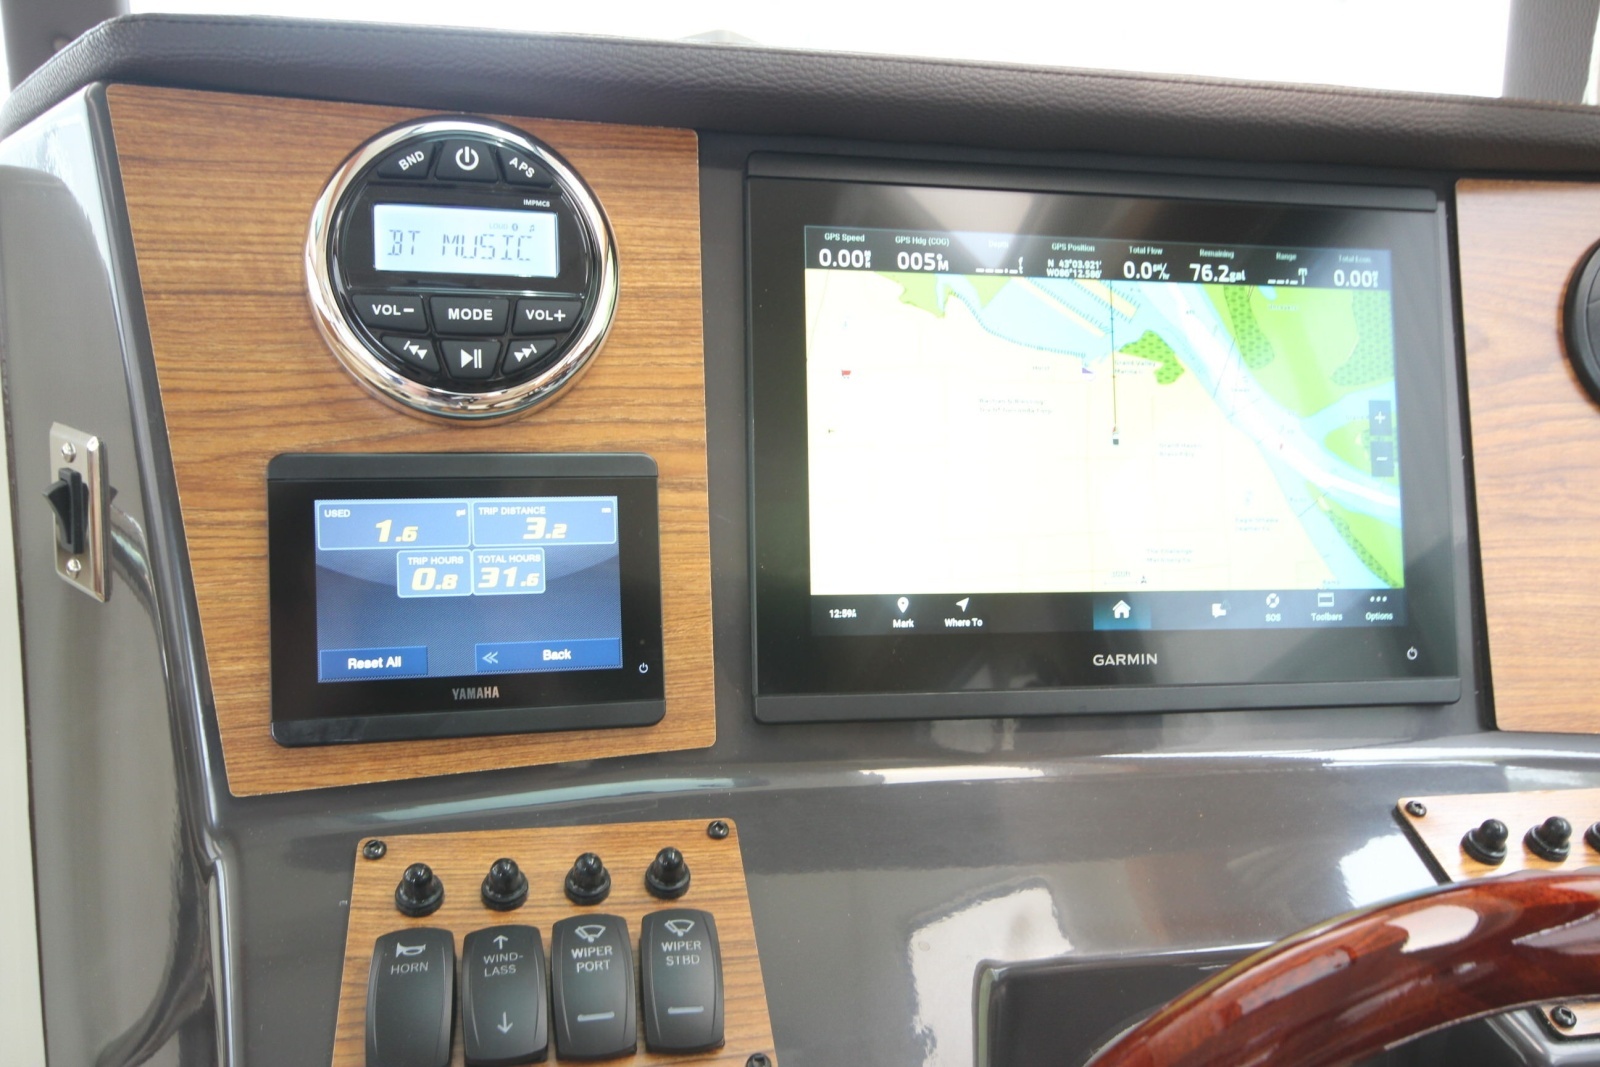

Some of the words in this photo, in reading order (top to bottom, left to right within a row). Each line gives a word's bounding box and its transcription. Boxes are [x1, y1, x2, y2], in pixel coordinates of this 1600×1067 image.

[398, 150, 425, 171] BND
[508, 156, 535, 178] APS
[824, 232, 840, 241] GPS
[841, 233, 866, 243] Speed
[895, 235, 910, 244] GPS
[912, 236, 927, 246] Hdg
[928, 237, 950, 247] (COG)
[387, 229, 421, 256] BT
[441, 233, 533, 261] MUSIC
[1051, 242, 1067, 251] GPS
[1067, 243, 1096, 252] Position
[1128, 245, 1147, 255] Total
[1199, 248, 1235, 259] Remaining
[447, 308, 493, 321] MODE
[324, 508, 350, 518] USED
[478, 507, 499, 515] TRIP
[500, 506, 546, 515] DISTANCE
[375, 519, 419, 543] 1.6
[522, 516, 568, 540] 3.2
[407, 557, 429, 565] TRIP
[430, 556, 464, 565] HOURS
[478, 555, 507, 564] TOTAL
[508, 554, 542, 563] HOURS
[411, 567, 459, 591] 0.8
[478, 566, 540, 589] 31.6
[892, 619, 914, 628] Mark
[944, 618, 970, 628] Where
[971, 618, 983, 627] To
[1265, 613, 1282, 622] SOS
[1310, 612, 1343, 622] Toolbars
[1365, 612, 1393, 622] Options
[542, 649, 572, 661] Back
[1092, 653, 1158, 667] GARMIN
[347, 658, 384, 670] Reset
[386, 655, 402, 668] All
[452, 686, 500, 701] YAMAHA
[571, 945, 614, 959] WIPER
[661, 940, 702, 953] WIPER
[483, 951, 525, 965] WIND-
[391, 961, 430, 976] HORN
[484, 965, 517, 978] LASS
[576, 959, 612, 973] PORT
